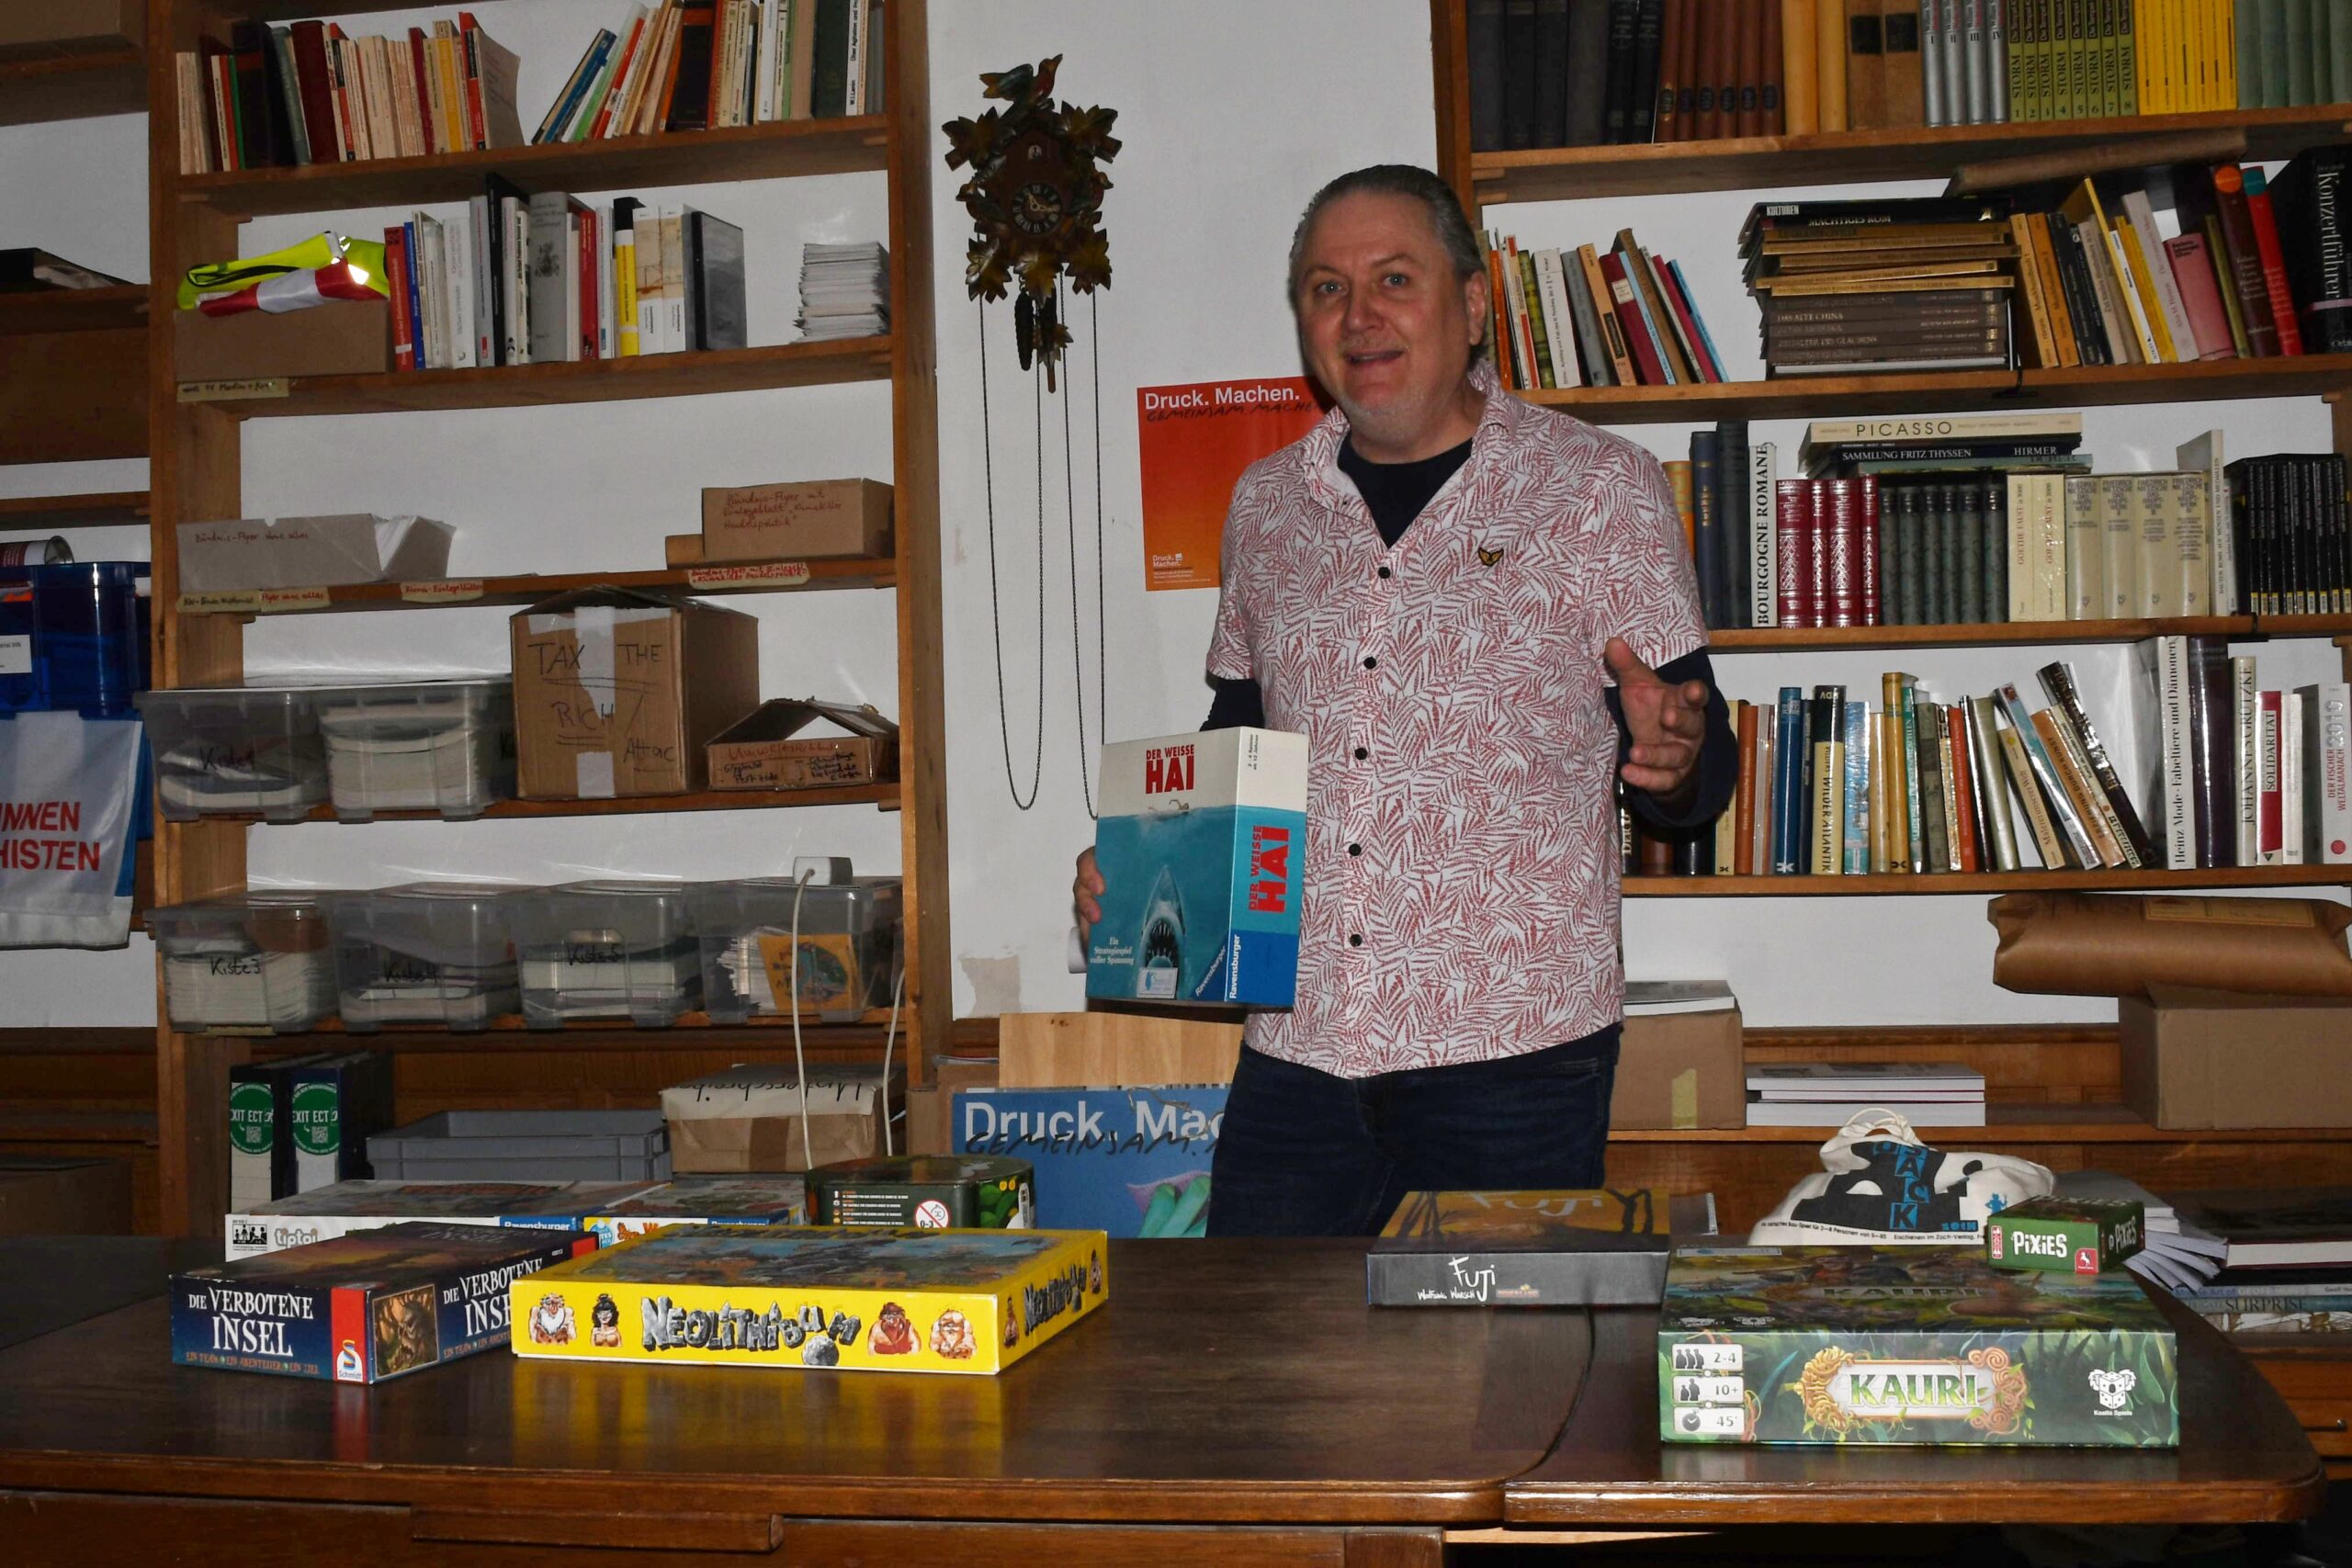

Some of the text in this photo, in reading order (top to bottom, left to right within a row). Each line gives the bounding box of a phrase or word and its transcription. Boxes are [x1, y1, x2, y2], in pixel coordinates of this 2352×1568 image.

[2011, 54, 2020, 98] STORM
[2026, 55, 2035, 98] STORM
[2041, 54, 2050, 96] STORM
[2056, 52, 2066, 96] STORM
[2073, 51, 2083, 94] STORM
[2088, 51, 2098, 94] STORM
[2105, 49, 2114, 92] STORM
[2120, 47, 2131, 90] STORM
[1766, 205, 1800, 217] KULTUREN
[2317, 170, 2345, 299] Konzertführer
[1145, 385, 1300, 410] Druck. Machen.
[1856, 422, 1952, 437] PICASSO
[1842, 446, 2058, 460] SAMMLUNG FRITZ THYSSEN HIRMER
[1755, 446, 1770, 625] BOURGOGNE ROMANE
[527, 642, 663, 675] TAX THE
[550, 701, 614, 731] RICH
[1146, 745, 1194, 761] DER WEISSE
[2169, 637, 2185, 863] Heinz Mode Fabeltiere und Dämonen
[1146, 758, 1194, 795] HAI
[2241, 740, 2256, 825] JOHANNES
[2327, 749, 2336, 798] DER FISCHER
[2336, 749, 2346, 811] WELTALMANACH
[1822, 776, 1833, 818] WILDER
[1822, 819, 1833, 872] ATLANTIK
[1249, 825, 1262, 910] DER WEISSE
[1257, 827, 1290, 914] HAI
[1195, 945, 1227, 998] Ravensburger
[1229, 934, 1241, 998] Ravensburger
[313, 1110, 329, 1122] ECT
[965, 1102, 1118, 1142] Druck.
[275, 1227, 318, 1249] tiptoi
[1834, 1227, 1859, 1237] Personen
[443, 1258, 543, 1304] DIE VERBOTENE
[188, 1286, 313, 1320] DIE VERBOTENE
[2225, 1296, 2306, 1312] SURPRISE
[212, 1313, 293, 1357] INSEL
[338, 1370, 362, 1379] Schmidt
[1713, 1351, 1737, 1364] 2-4
[1714, 1384, 1739, 1396] 10+
[1849, 1374, 1979, 1408] KAURI
